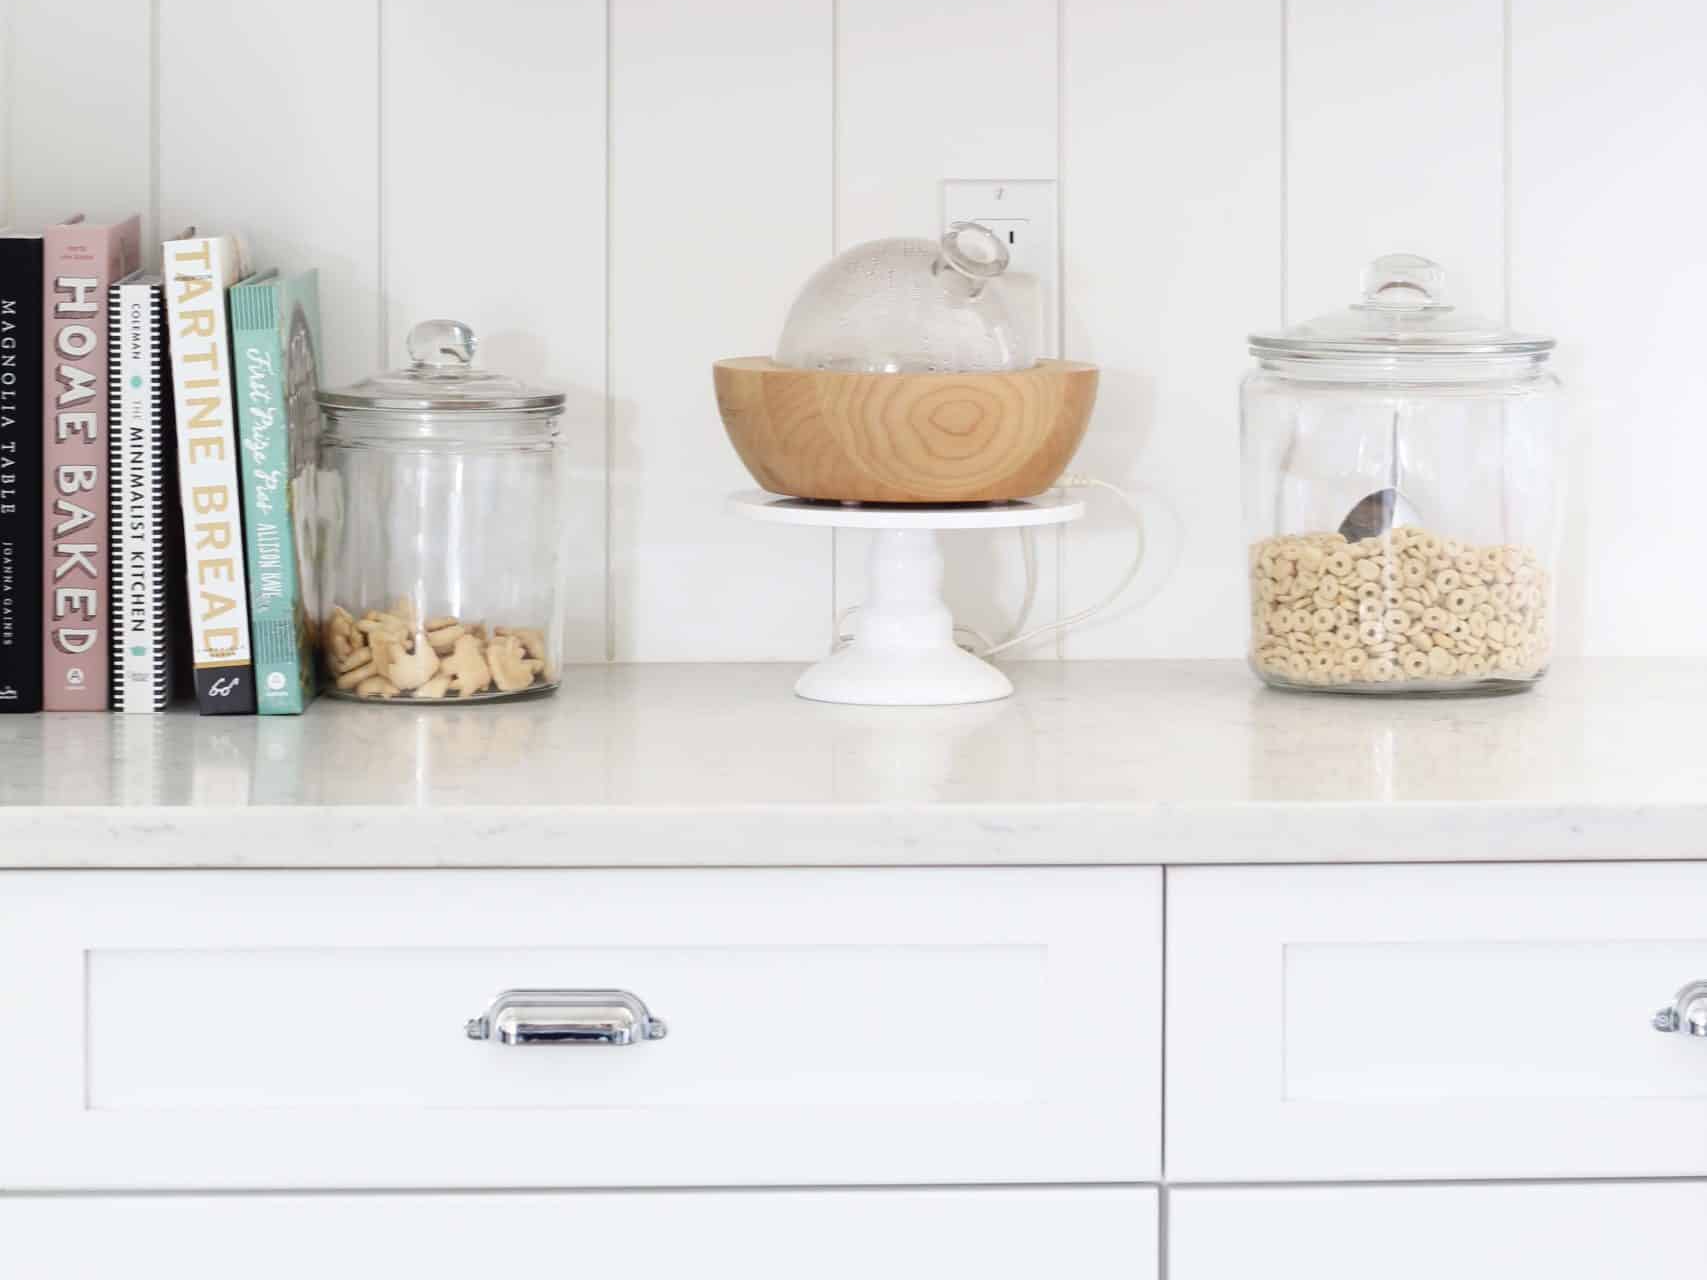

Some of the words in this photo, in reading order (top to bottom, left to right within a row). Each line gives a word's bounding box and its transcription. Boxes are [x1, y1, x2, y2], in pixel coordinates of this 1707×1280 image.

[1, 300, 17, 428] MAGNOLIA
[55, 276, 98, 444] HOME
[130, 303, 142, 360] COLEMAN
[174, 240, 226, 465] TARTINE
[247, 347, 275, 404] First
[1, 441, 17, 514] TABLE
[129, 426, 146, 542] MINIMALIST
[243, 406, 278, 465] Prize
[54, 464, 98, 655] BAKED
[130, 551, 146, 633] KITCHEN
[191, 483, 241, 658] BREAD
[255, 522, 281, 569] ALLISON
